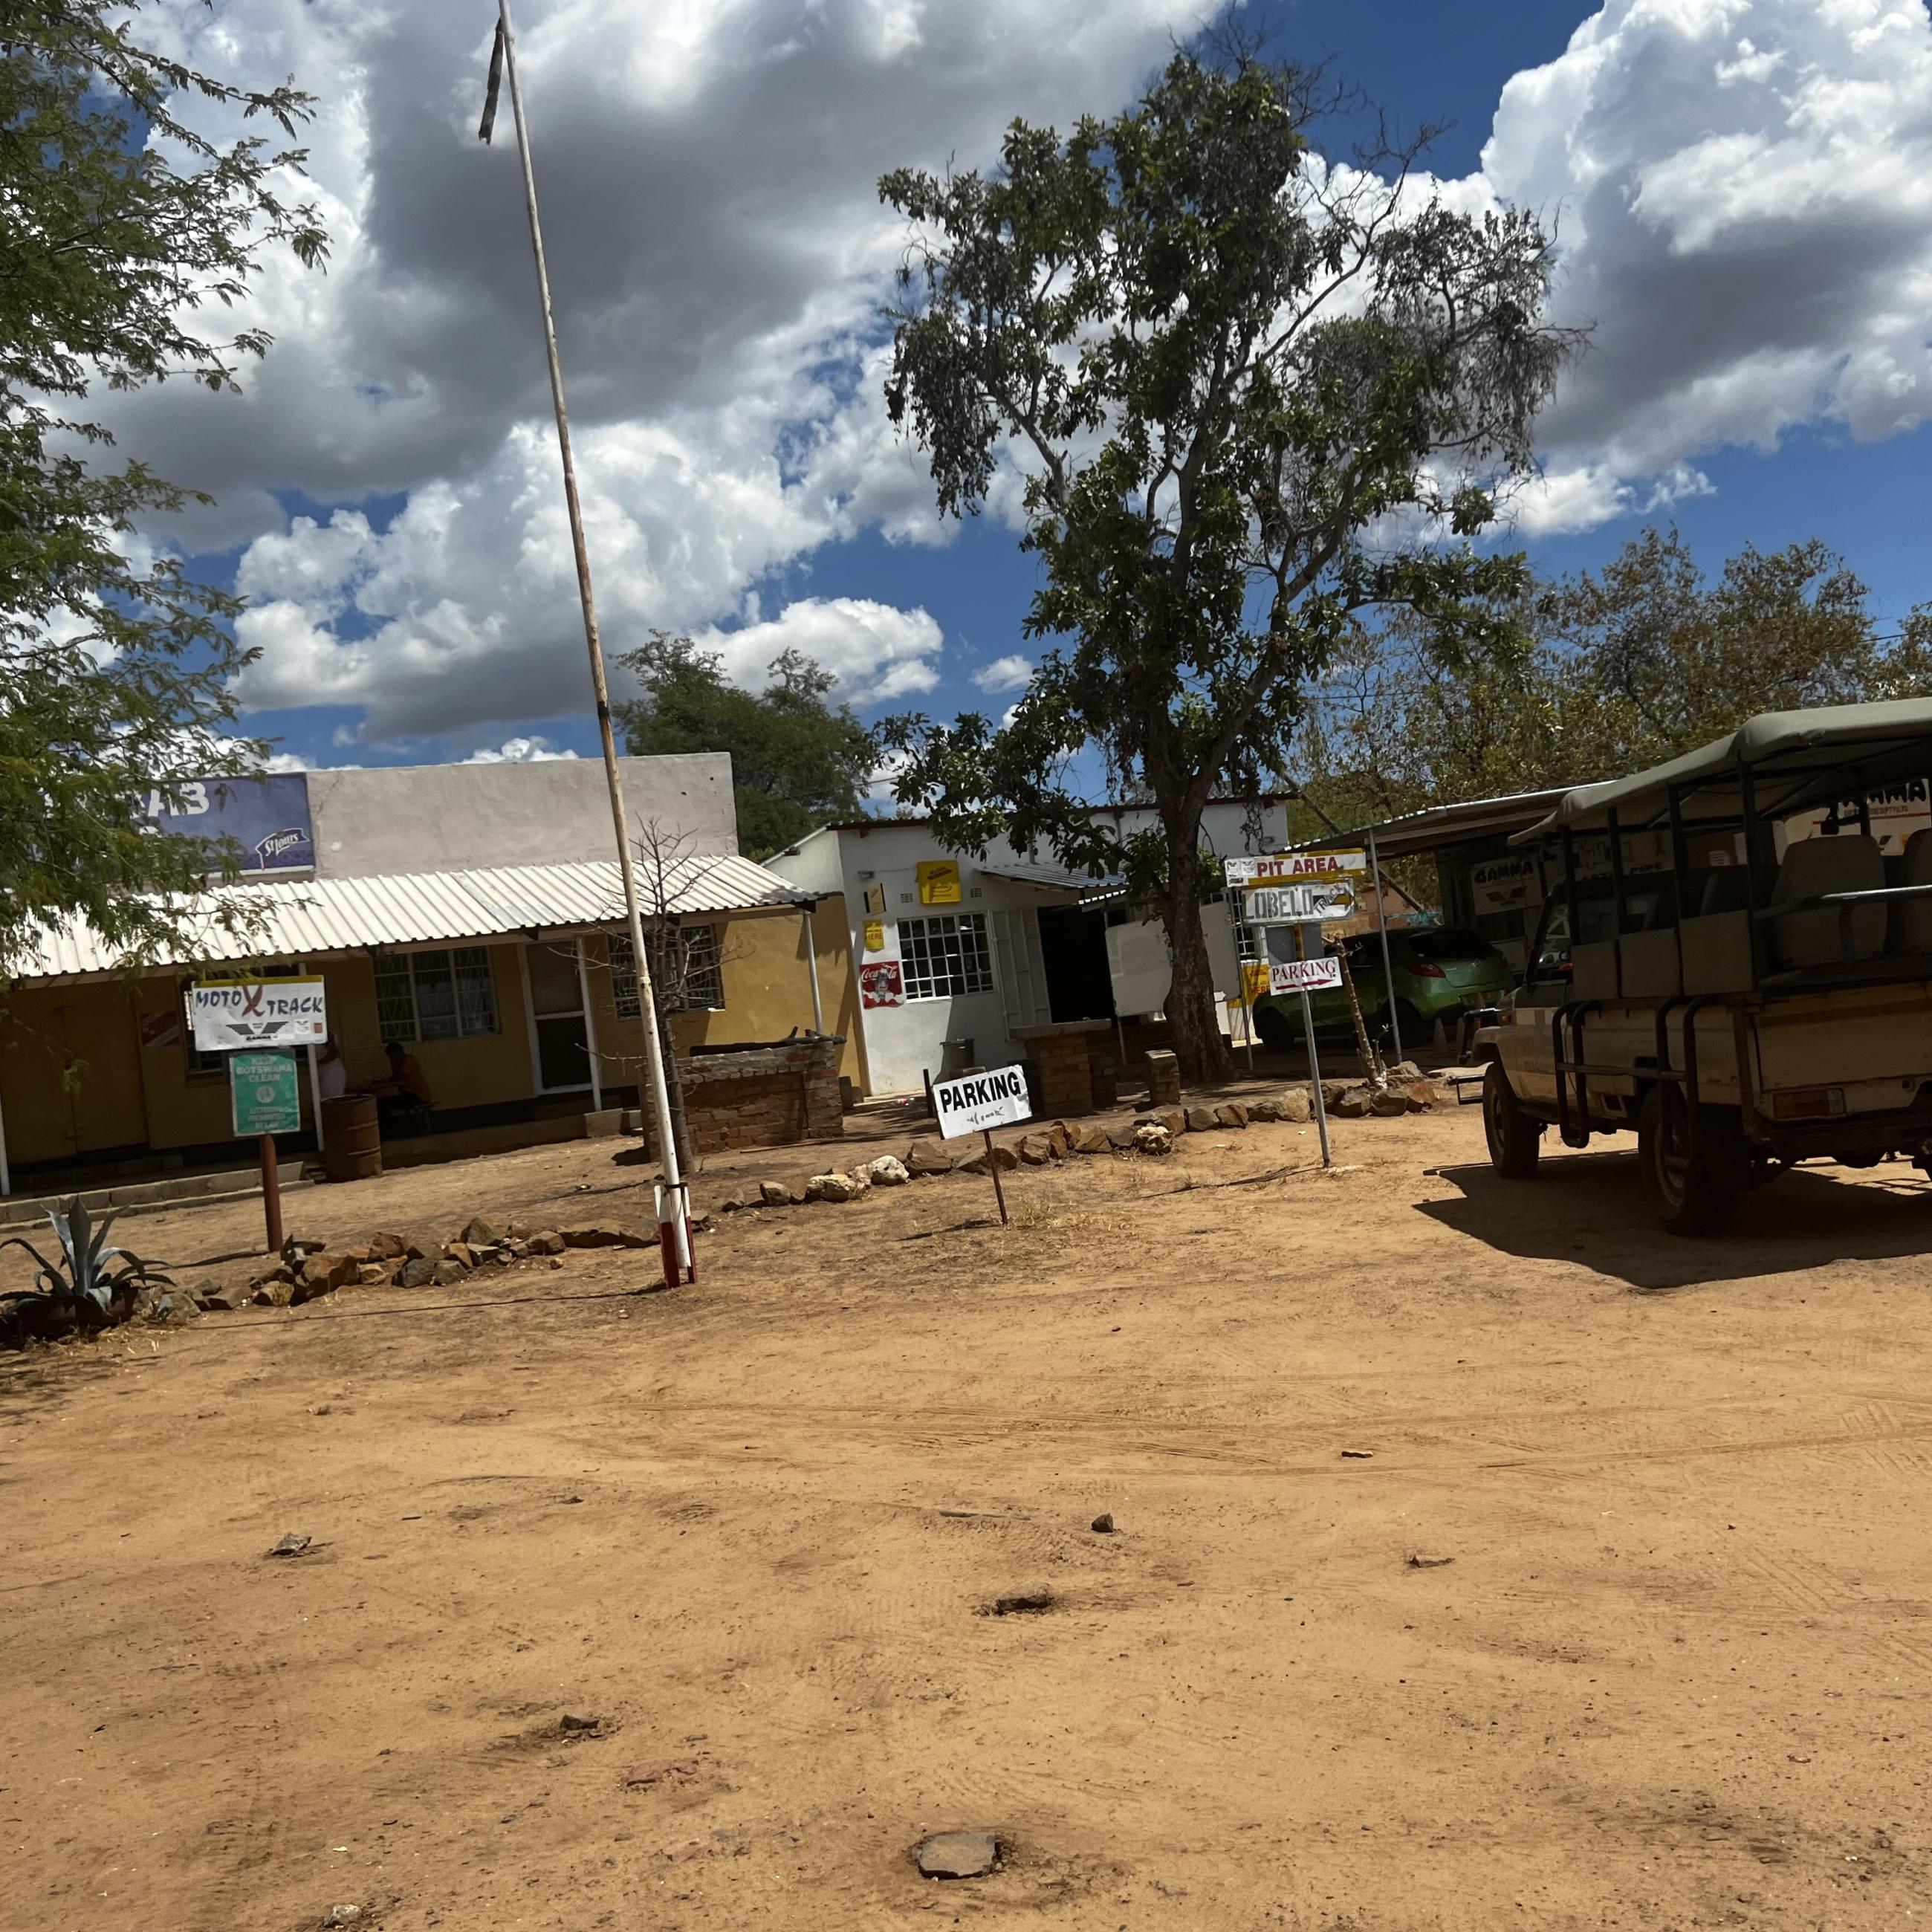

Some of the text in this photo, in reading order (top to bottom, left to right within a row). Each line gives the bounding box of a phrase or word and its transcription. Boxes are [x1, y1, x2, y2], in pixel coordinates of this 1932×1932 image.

[1257, 860, 1284, 877] PIT
[1291, 856, 1339, 875] AREA
[1271, 959, 1337, 982] PARKING
[195, 985, 323, 1017] MOTO X TRACK
[236, 1063, 293, 1074] BOTSWANA
[939, 1072, 1022, 1114] PARKING
